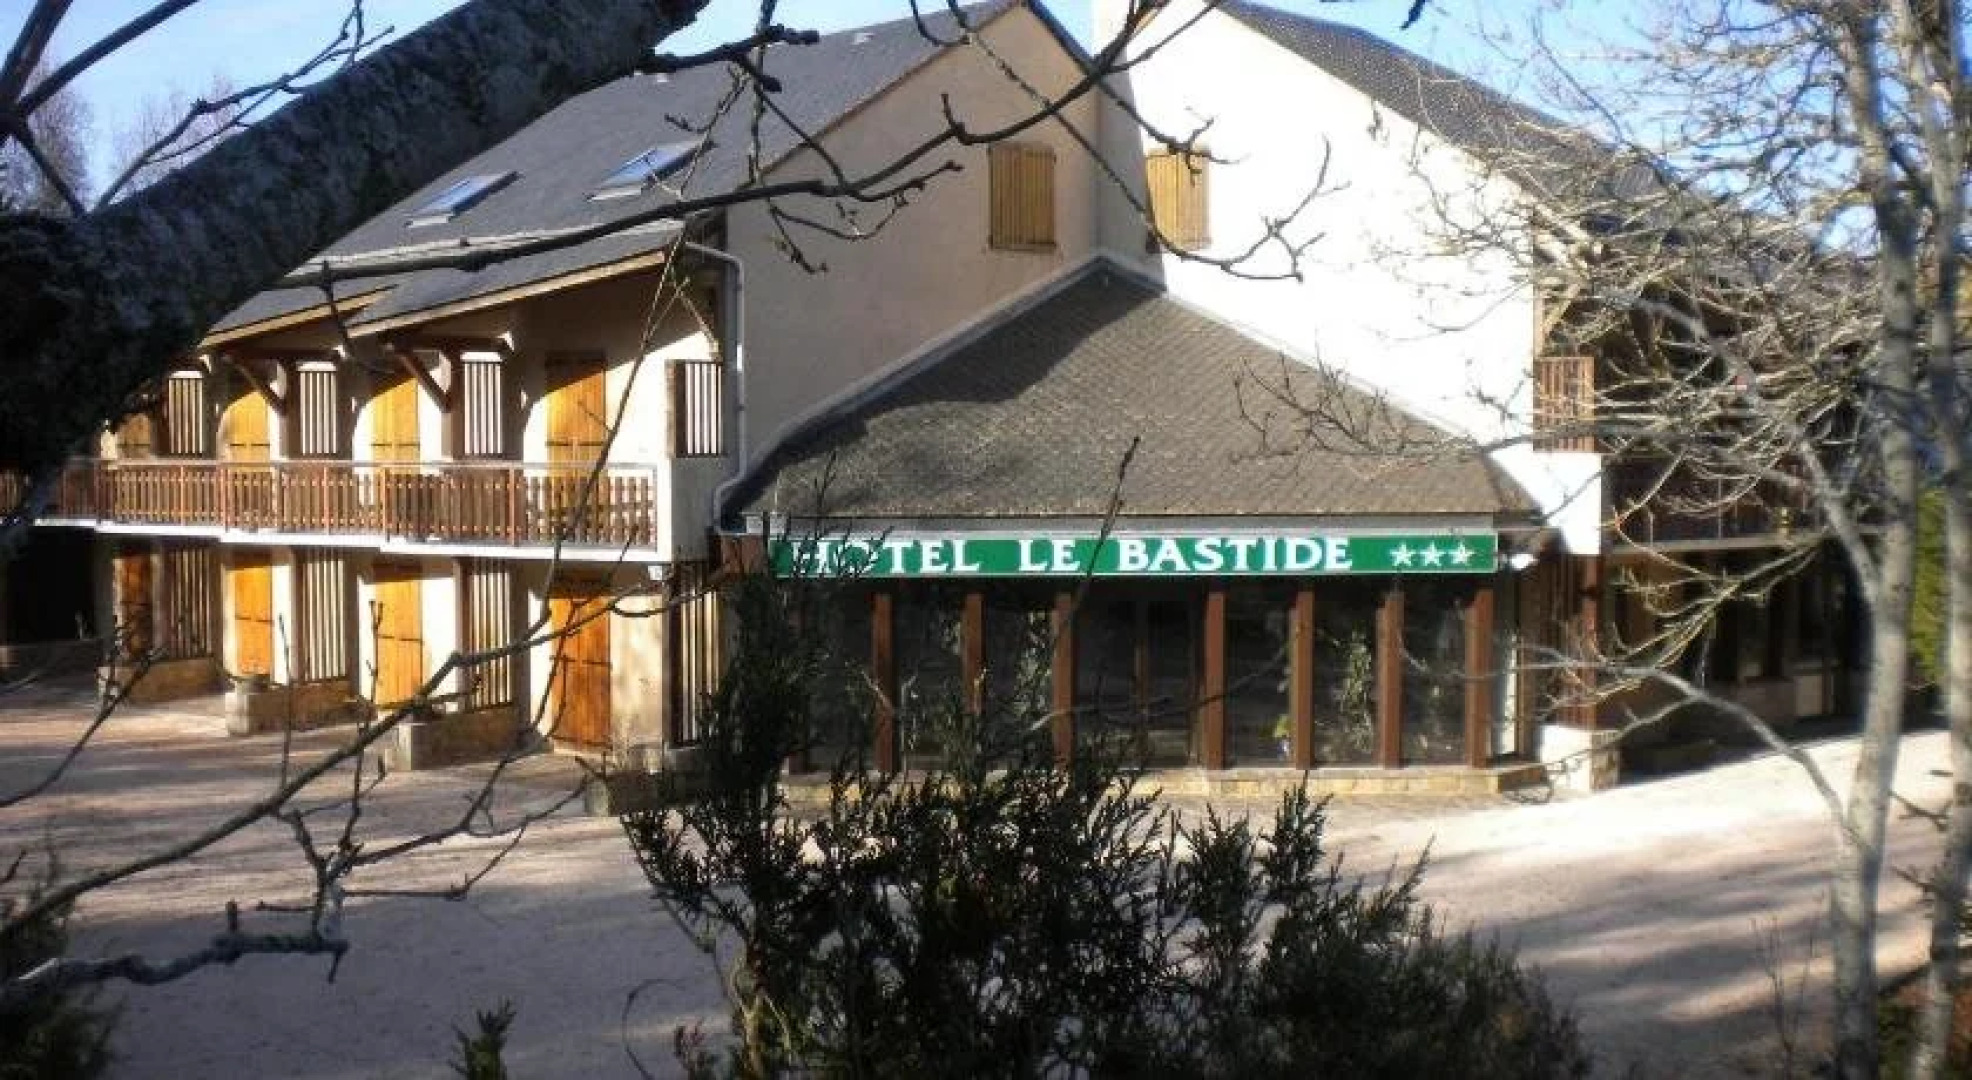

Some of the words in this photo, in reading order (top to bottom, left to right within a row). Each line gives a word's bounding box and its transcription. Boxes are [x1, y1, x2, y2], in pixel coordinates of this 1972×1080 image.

[791, 538, 979, 574] HOTEL
[1018, 539, 1080, 572] LE
[1117, 538, 1353, 571] BASTIDE
